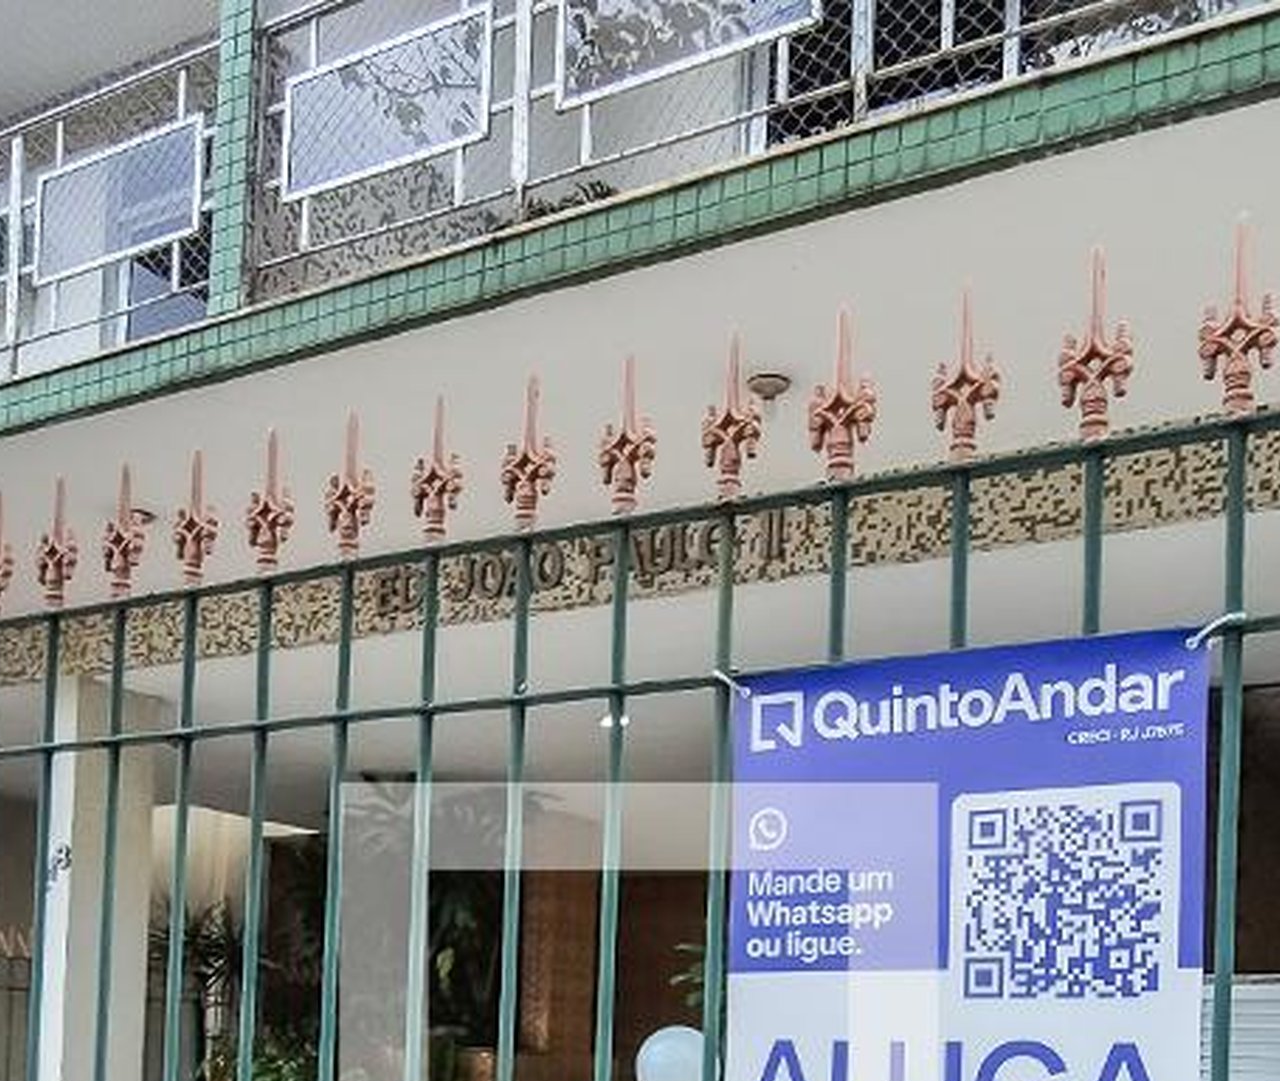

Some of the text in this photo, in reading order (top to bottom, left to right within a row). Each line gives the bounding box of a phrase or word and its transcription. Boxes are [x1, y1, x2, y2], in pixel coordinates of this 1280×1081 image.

[813, 663, 1186, 741] QuintoAndar
[748, 868, 893, 897] Mande um
[746, 900, 893, 930] Whatsapp
[746, 931, 862, 963] ou ligue.
